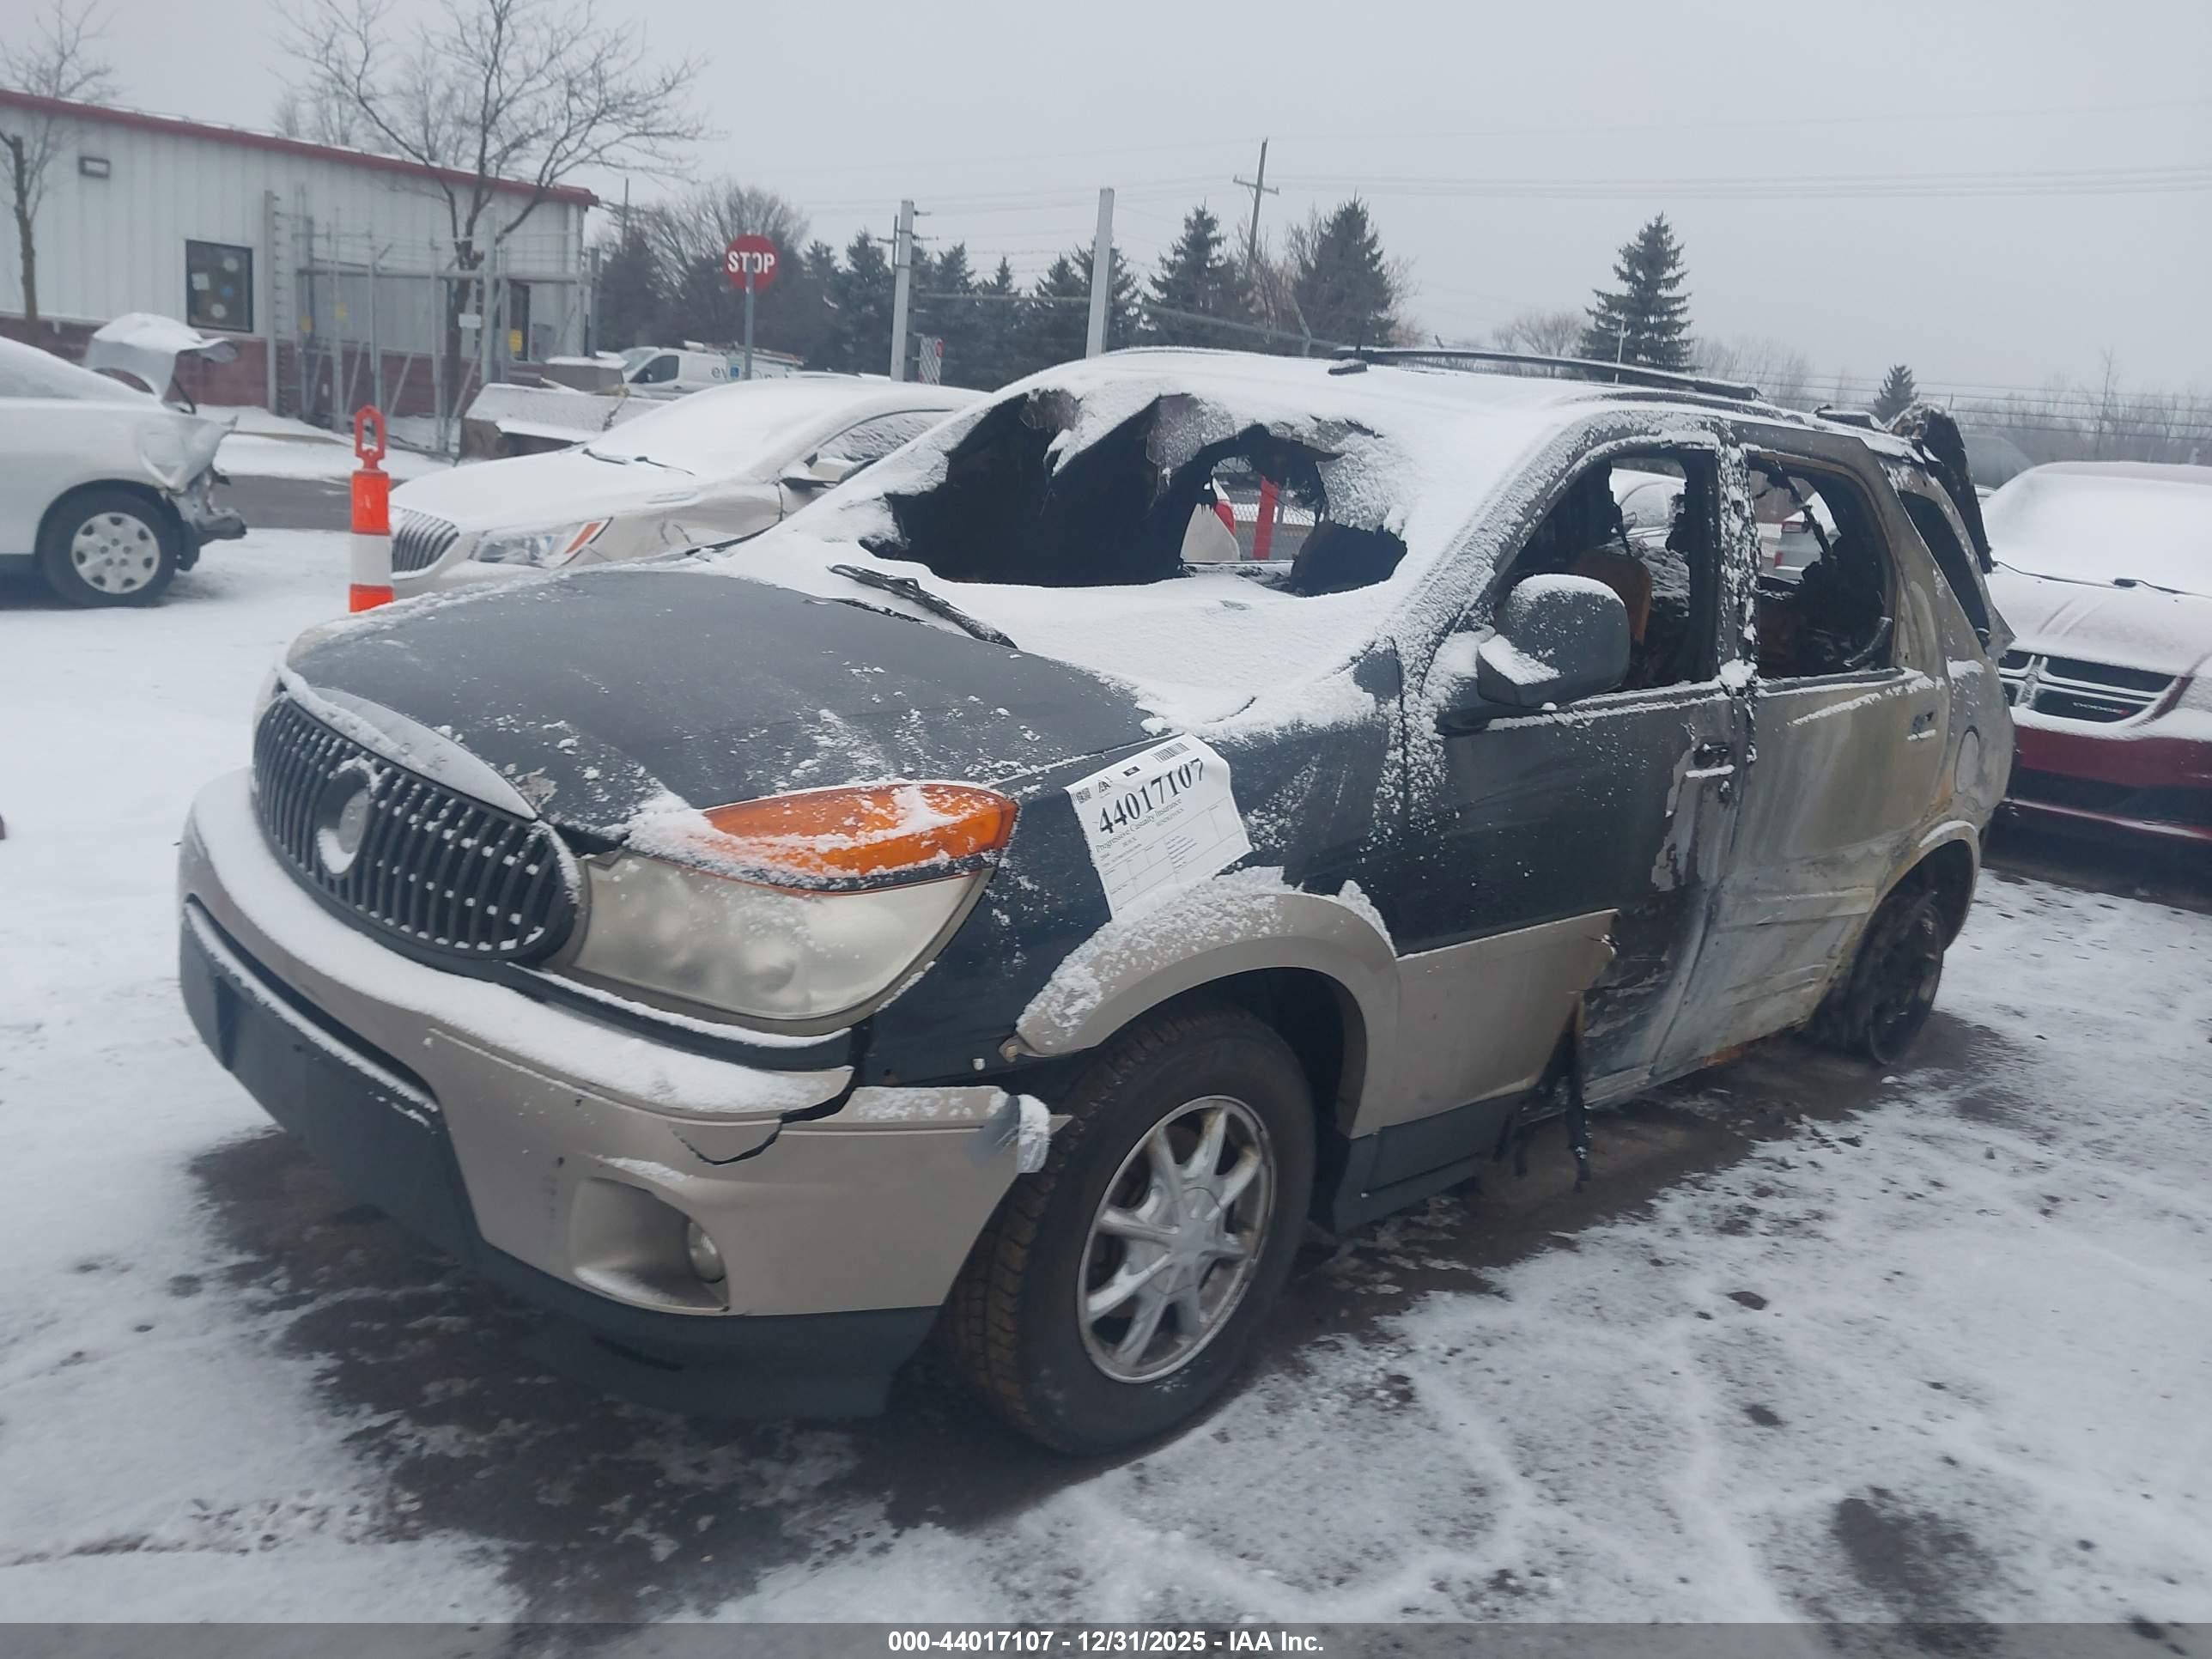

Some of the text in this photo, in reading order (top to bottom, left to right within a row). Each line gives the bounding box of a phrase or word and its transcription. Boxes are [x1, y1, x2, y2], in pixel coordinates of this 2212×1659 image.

[727, 251, 775, 274] STOP
[1099, 757, 1204, 834] 44017107
[1095, 829, 1131, 853] Progressive
[1129, 814, 1155, 832] Casualty
[1154, 798, 1183, 817] Insurance
